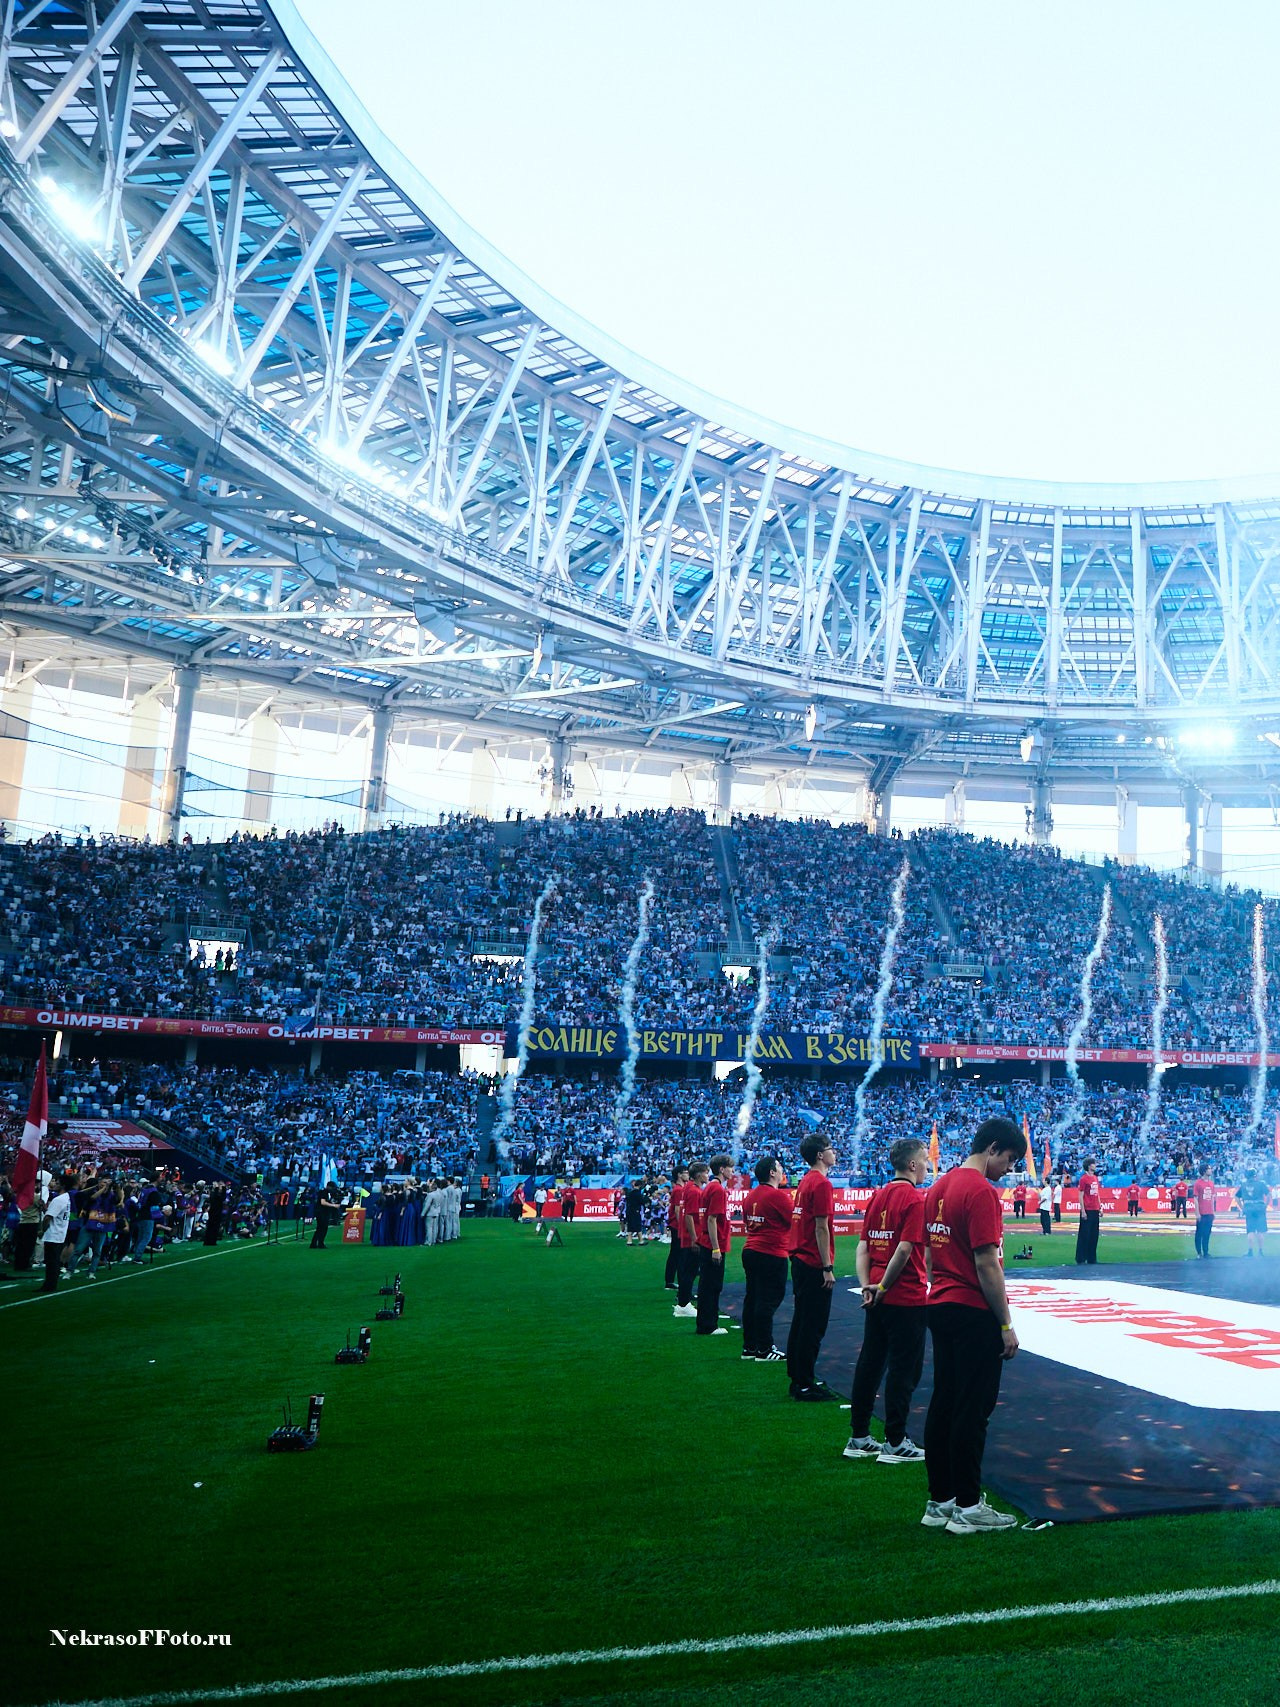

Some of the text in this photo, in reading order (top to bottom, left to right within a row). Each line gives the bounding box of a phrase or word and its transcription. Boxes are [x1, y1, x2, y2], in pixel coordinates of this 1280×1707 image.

[36, 1011, 144, 1031] OLIMPBET
[737, 1034, 793, 1059] НАМ
[1181, 1052, 1253, 1064] OLIMPBET
